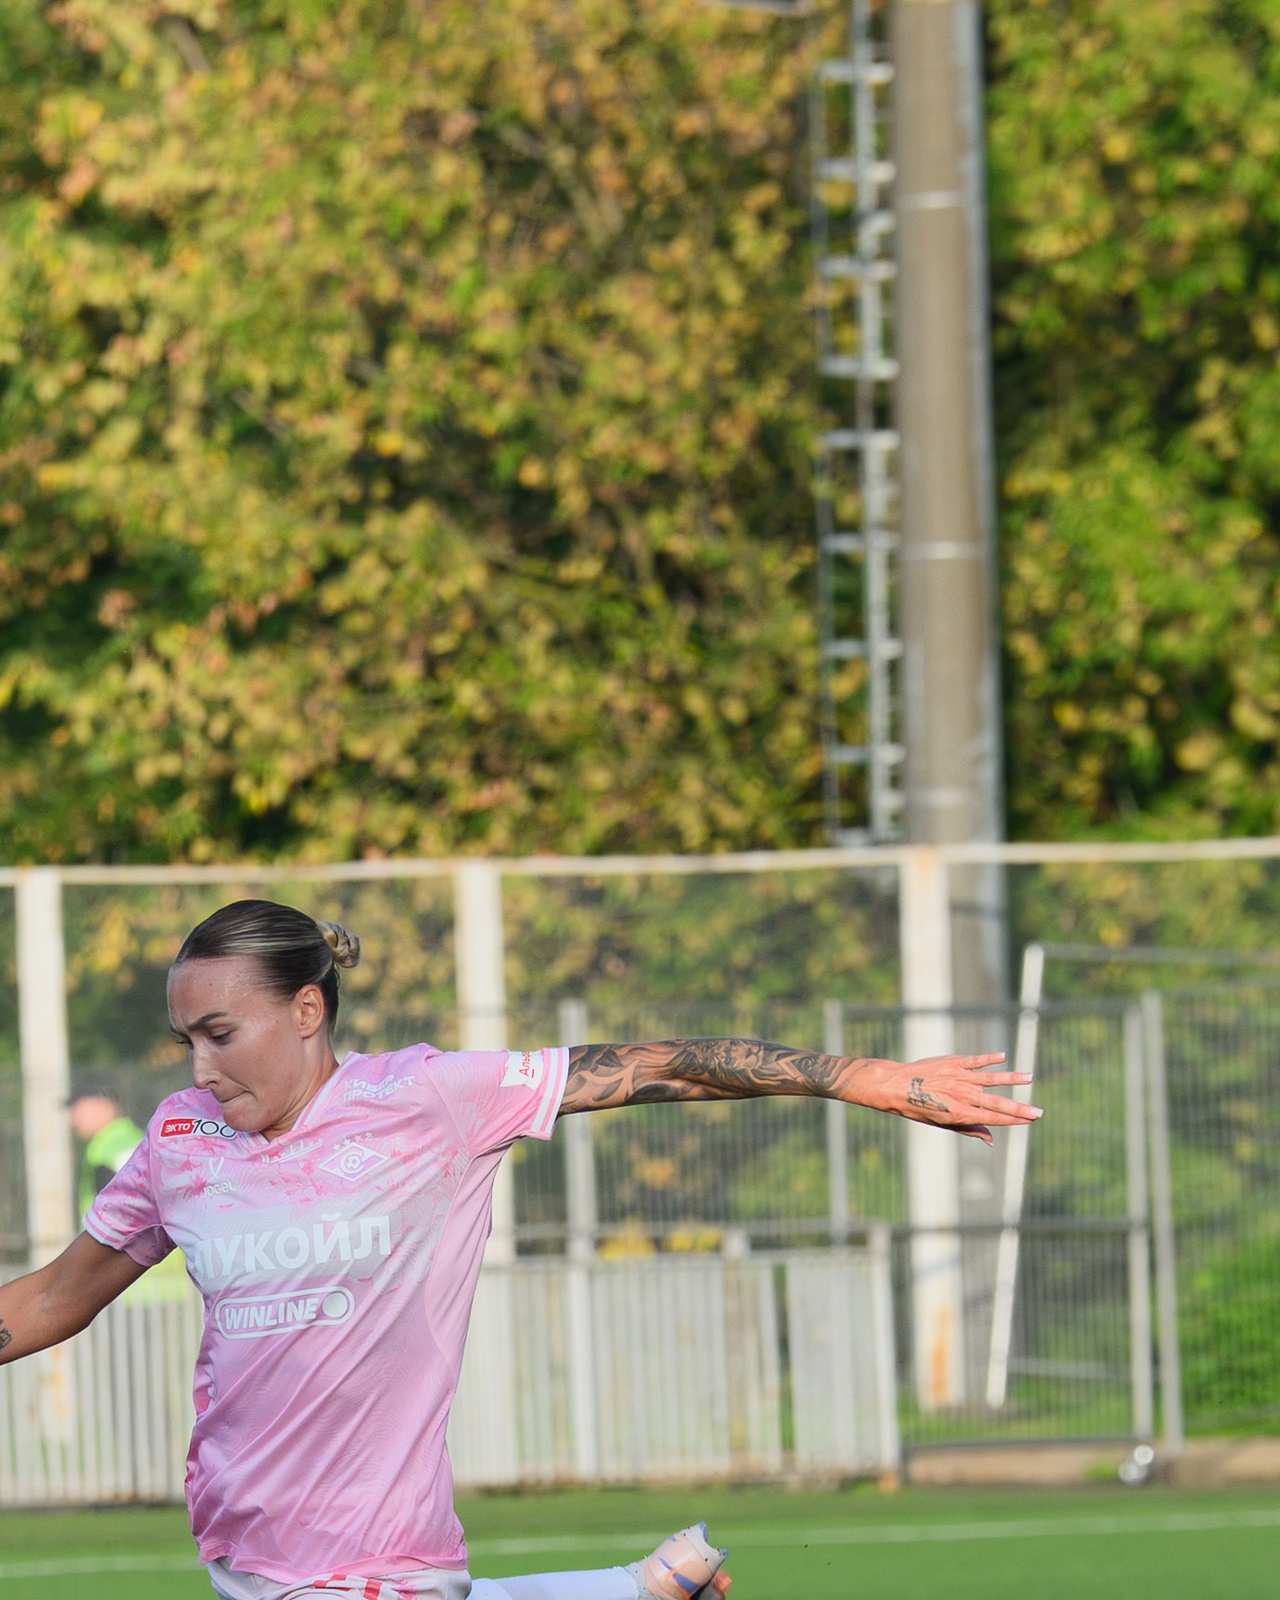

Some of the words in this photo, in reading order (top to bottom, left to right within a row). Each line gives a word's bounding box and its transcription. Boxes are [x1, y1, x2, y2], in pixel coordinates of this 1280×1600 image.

[343, 1075, 416, 1101] ПРОТЕКТ
[194, 1212, 392, 1281] ЛУКОЙЛ
[224, 1297, 320, 1330] WINLINE
